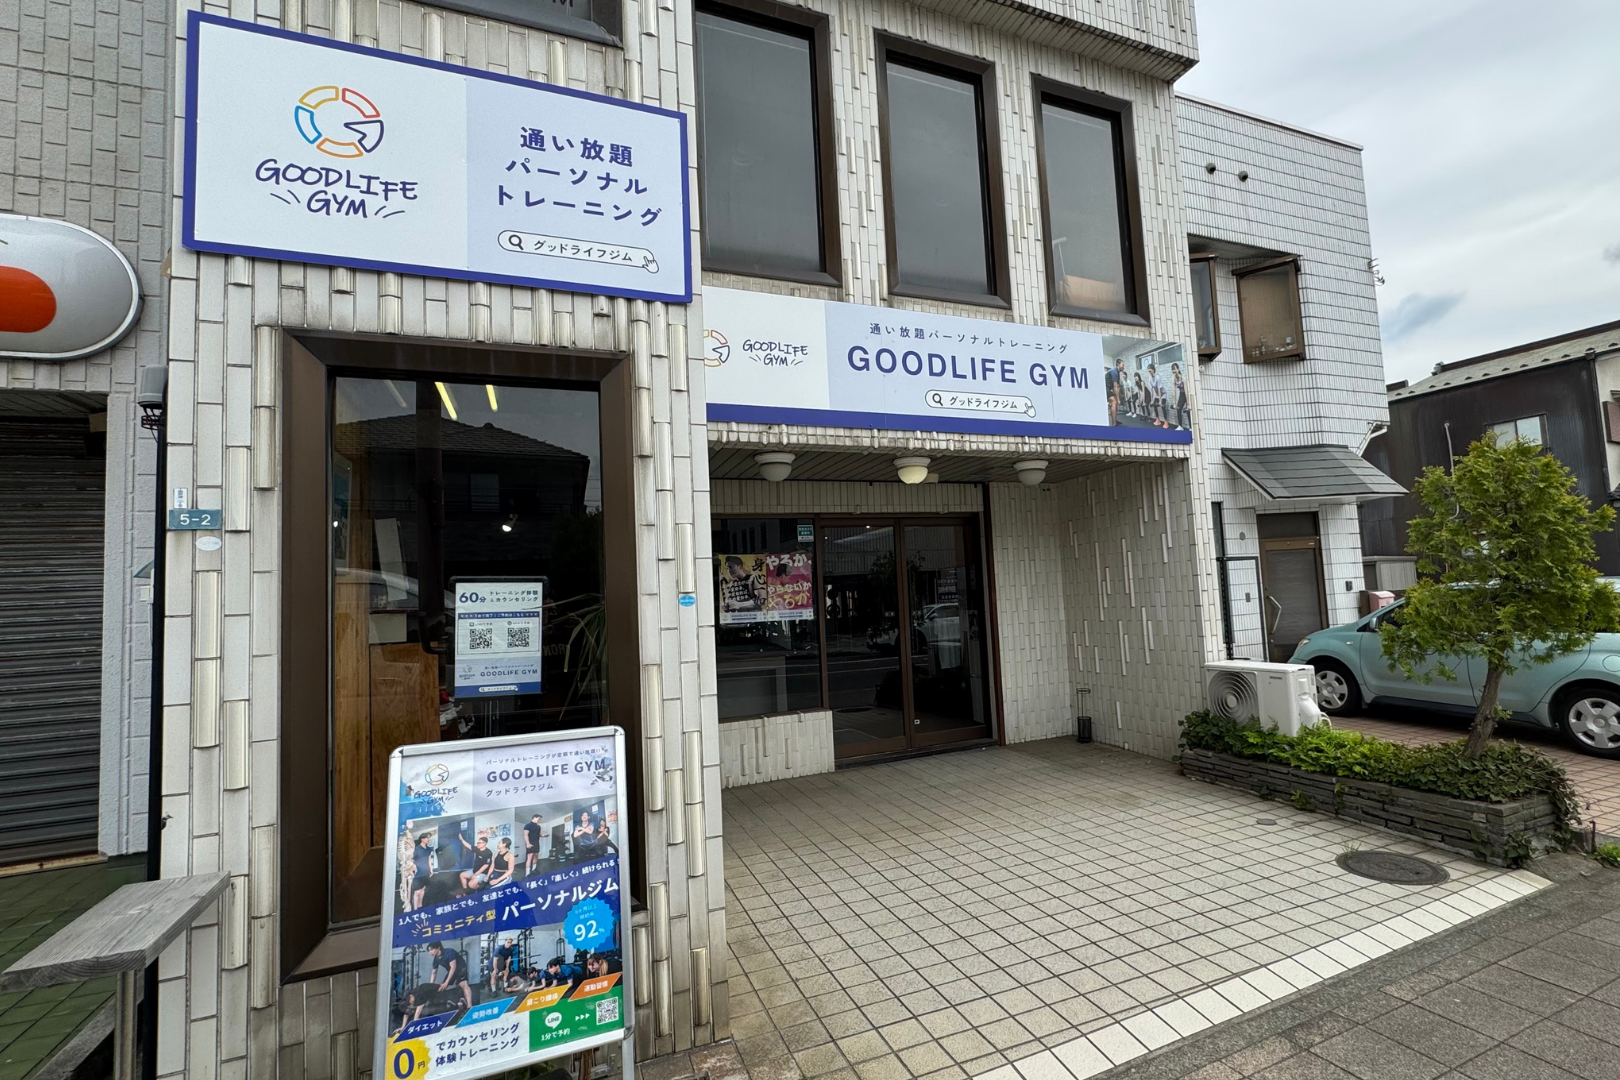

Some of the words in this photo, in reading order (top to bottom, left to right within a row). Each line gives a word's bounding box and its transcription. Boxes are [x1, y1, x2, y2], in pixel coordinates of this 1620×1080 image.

[520, 126, 633, 167] 通い放題
[255, 158, 418, 200] GOODLIFE
[506, 157, 648, 195] パーソナル
[307, 189, 368, 218] GYM
[498, 185, 663, 226] トレーニング
[533, 239, 633, 263] グッドライフジム
[743, 339, 808, 357] GOODLIFE
[869, 322, 1068, 355] 通い放題パーソナルトレーニング
[763, 353, 788, 367] GYM
[848, 345, 1017, 384] GOODLIFE
[1030, 362, 1089, 389] GYM
[949, 395, 1018, 411] グッドライフジム
[180, 513, 211, 525] 5-2
[459, 591, 486, 603] 60分
[487, 763, 569, 783] GOODLIFE
[574, 757, 606, 773] GYM
[413, 786, 458, 799] GOODLIFE
[486, 783, 553, 797] グッドライフジム
[422, 909, 496, 938] コミュニティ型
[502, 877, 619, 921] パーソナルジム
[407, 1020, 442, 1034] ダイエット
[436, 1022, 520, 1051] でカウンセリング
[541, 1028, 570, 1041] 1分で予約
[435, 1035, 520, 1068] 体験トレーニング
